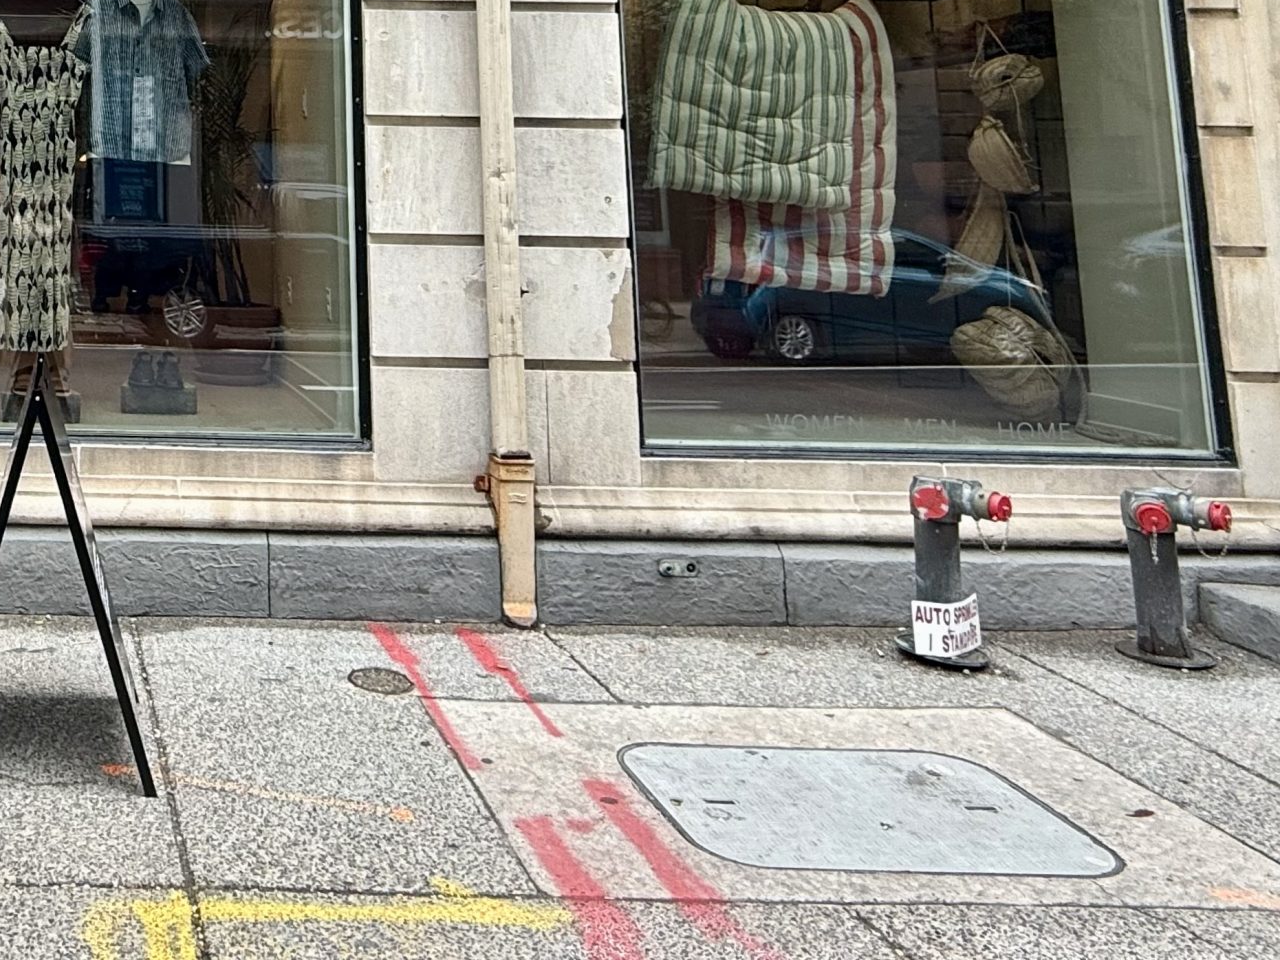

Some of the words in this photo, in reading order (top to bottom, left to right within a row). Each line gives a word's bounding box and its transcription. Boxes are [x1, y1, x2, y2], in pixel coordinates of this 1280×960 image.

[765, 413, 864, 432] WOMEN
[903, 418, 957, 439] MEN
[997, 421, 1070, 440] HOME
[915, 606, 950, 626] AUTO
